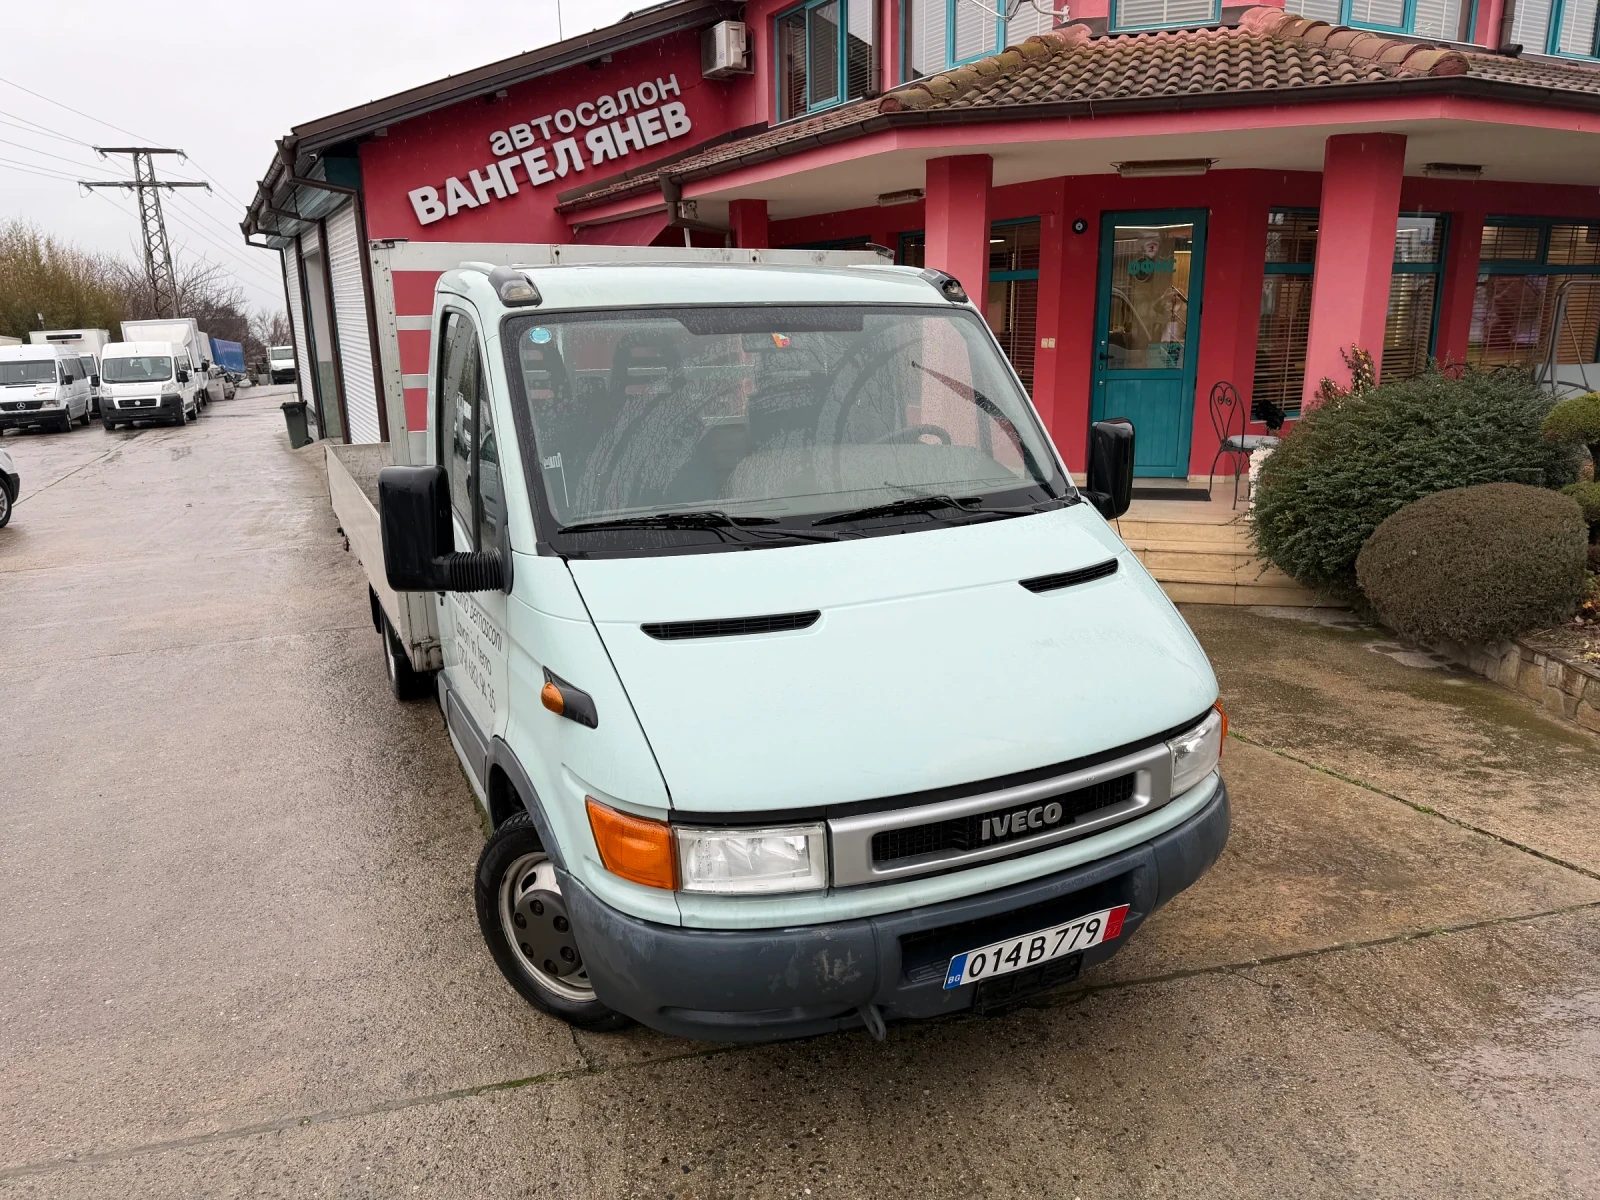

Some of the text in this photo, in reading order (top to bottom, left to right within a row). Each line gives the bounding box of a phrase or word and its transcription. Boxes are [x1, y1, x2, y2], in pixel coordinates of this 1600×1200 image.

[489, 73, 681, 156] автосалон
[408, 101, 692, 226] ВАНГЕЛ ЯНЕВ
[1128, 258, 1176, 275] ОФИС
[982, 802, 1062, 840] IVECO
[948, 974, 961, 984] BG
